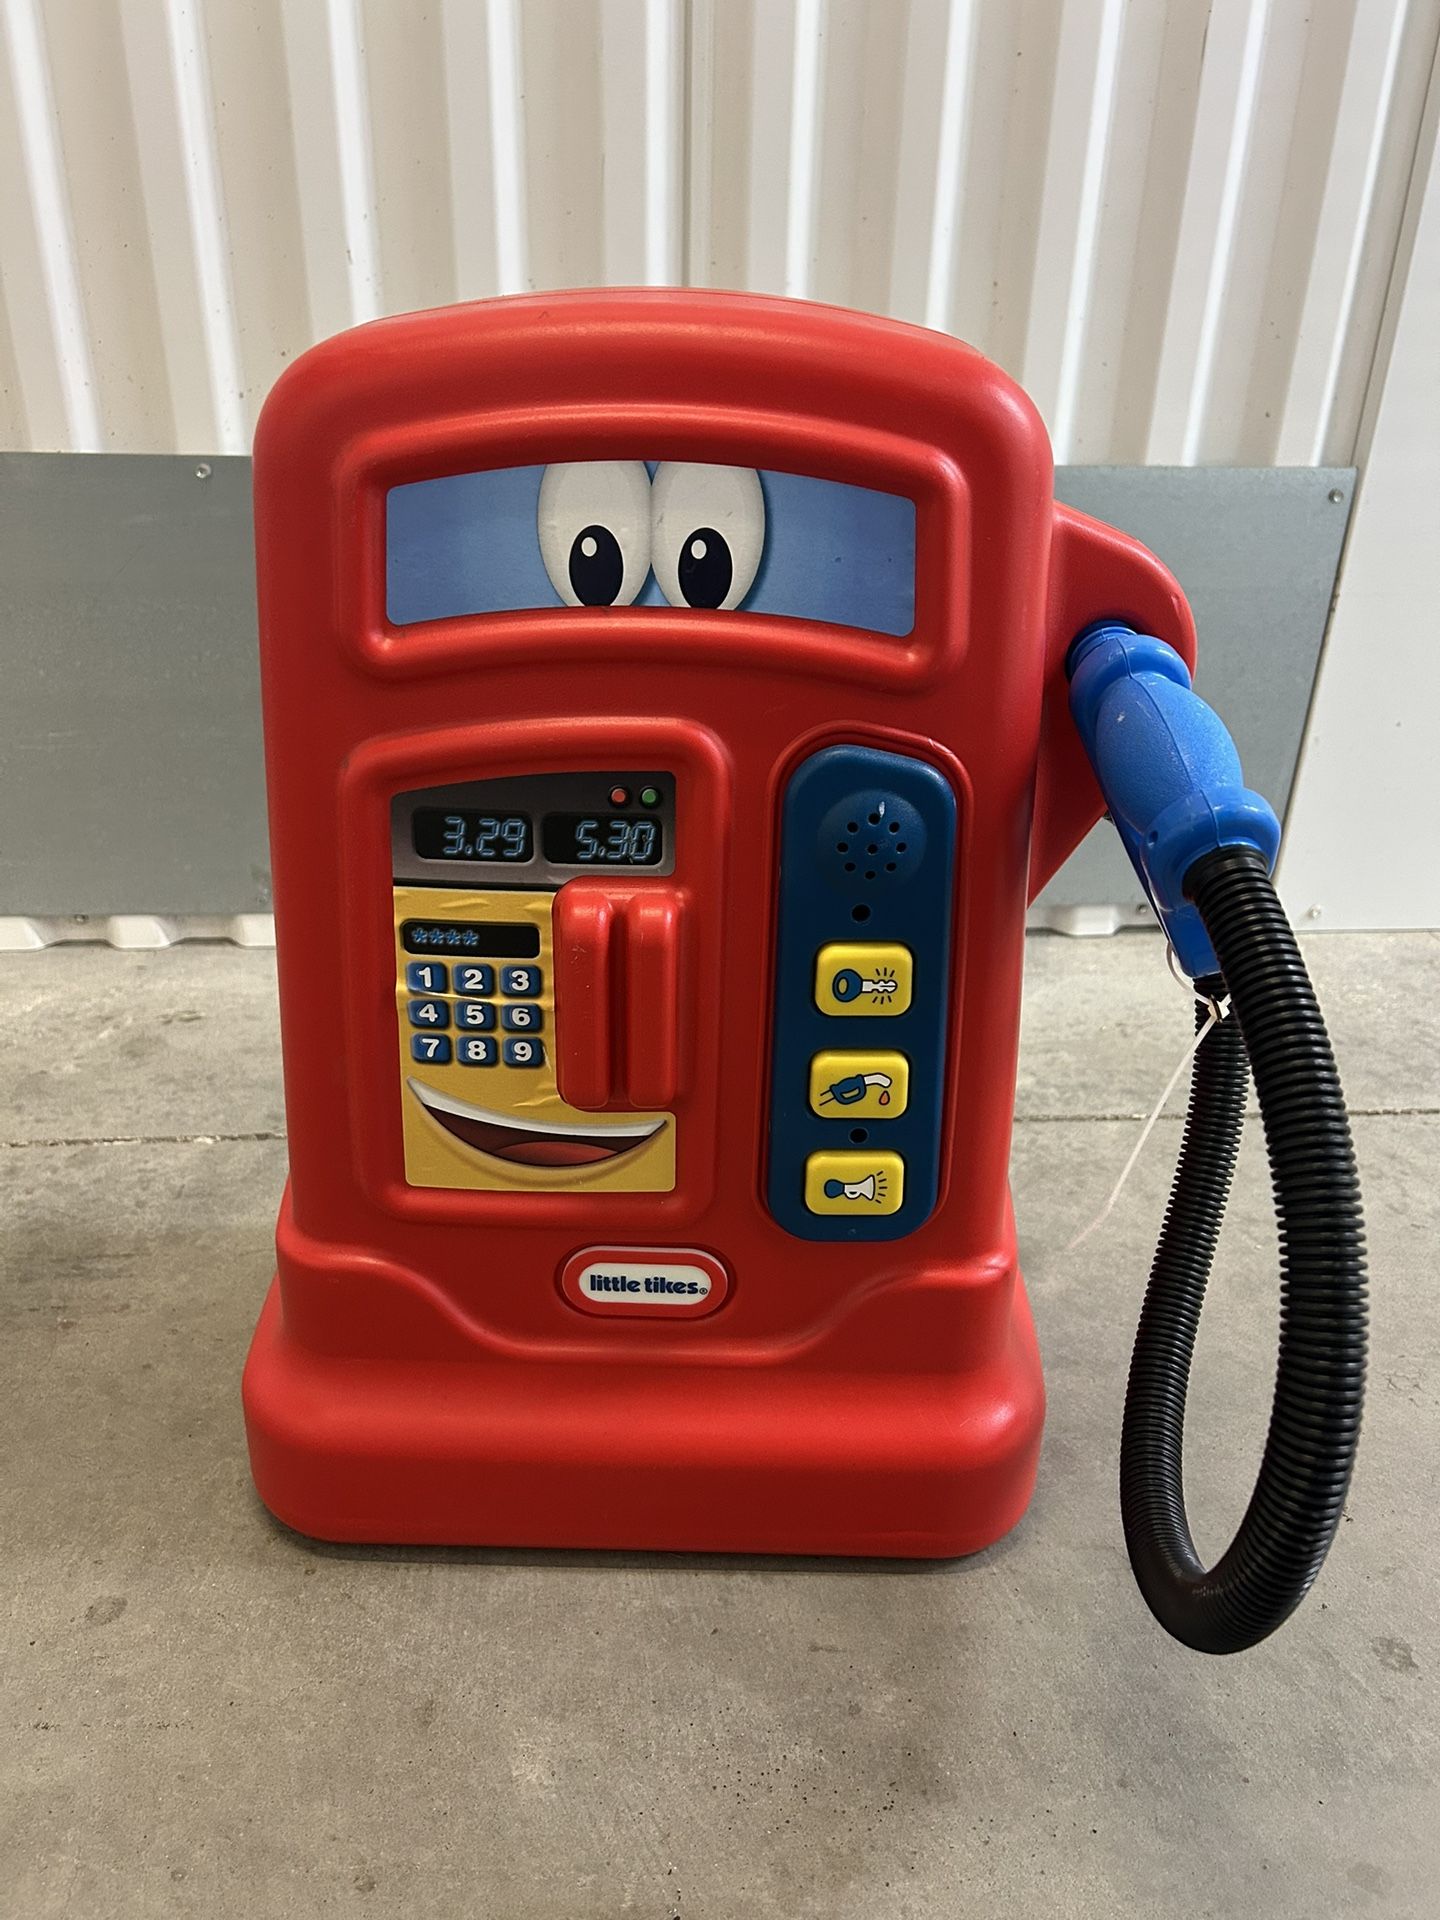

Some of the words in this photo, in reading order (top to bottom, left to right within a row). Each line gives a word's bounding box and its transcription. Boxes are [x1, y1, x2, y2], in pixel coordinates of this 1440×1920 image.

[443, 816, 526, 855] 3.29
[576, 821, 656, 859] 5.30
[418, 967, 432, 988] 1
[464, 969, 483, 990] 2
[511, 970, 529, 990] 3
[418, 1004, 438, 1022] 4
[466, 1004, 485, 1025] 5
[511, 1008, 531, 1027] 6
[421, 1038, 440, 1058] 7
[467, 1040, 487, 1060] 8
[513, 1042, 533, 1062] 9
[590, 1274, 641, 1293] little
